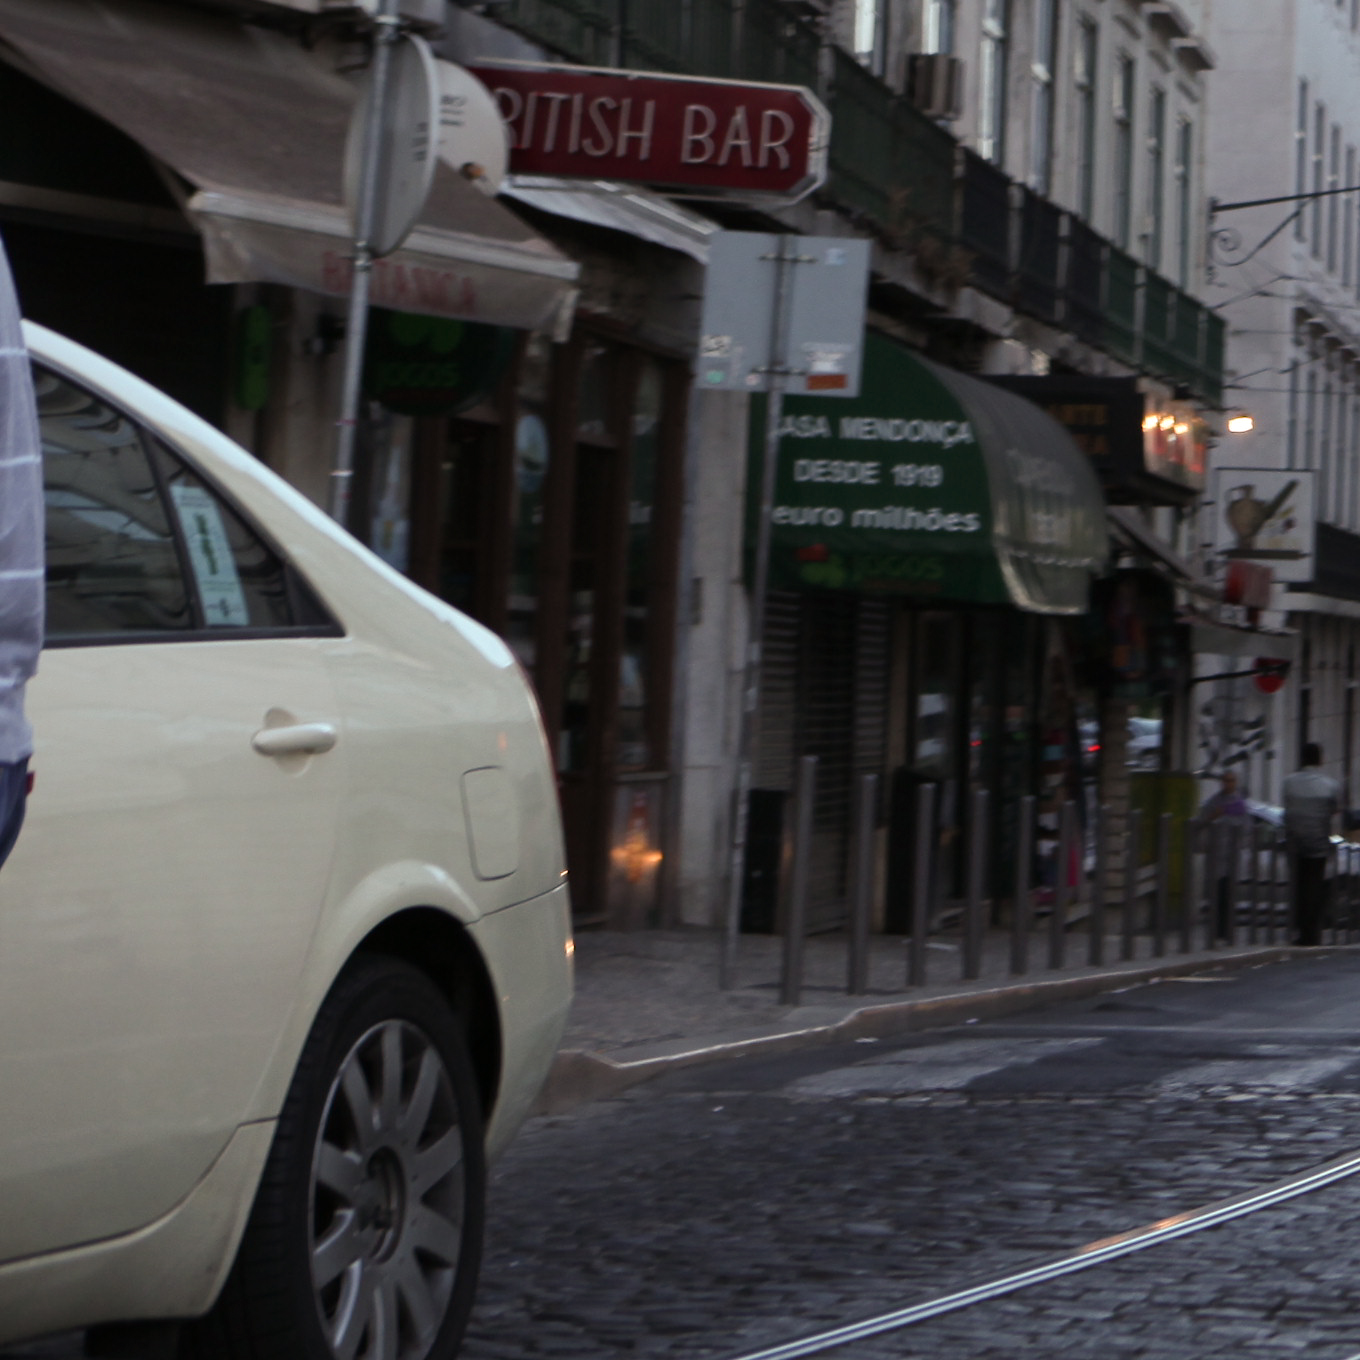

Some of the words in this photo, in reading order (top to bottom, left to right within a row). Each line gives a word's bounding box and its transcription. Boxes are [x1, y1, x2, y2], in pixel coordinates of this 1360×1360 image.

[492, 86, 656, 162] RITISH
[680, 103, 795, 170] BAR
[777, 414, 832, 439] ASA
[839, 416, 975, 449] MENDONÇA
[793, 459, 881, 485] DESDE
[889, 463, 944, 488] 1919
[771, 506, 844, 527] euro
[851, 505, 982, 533] milhões
